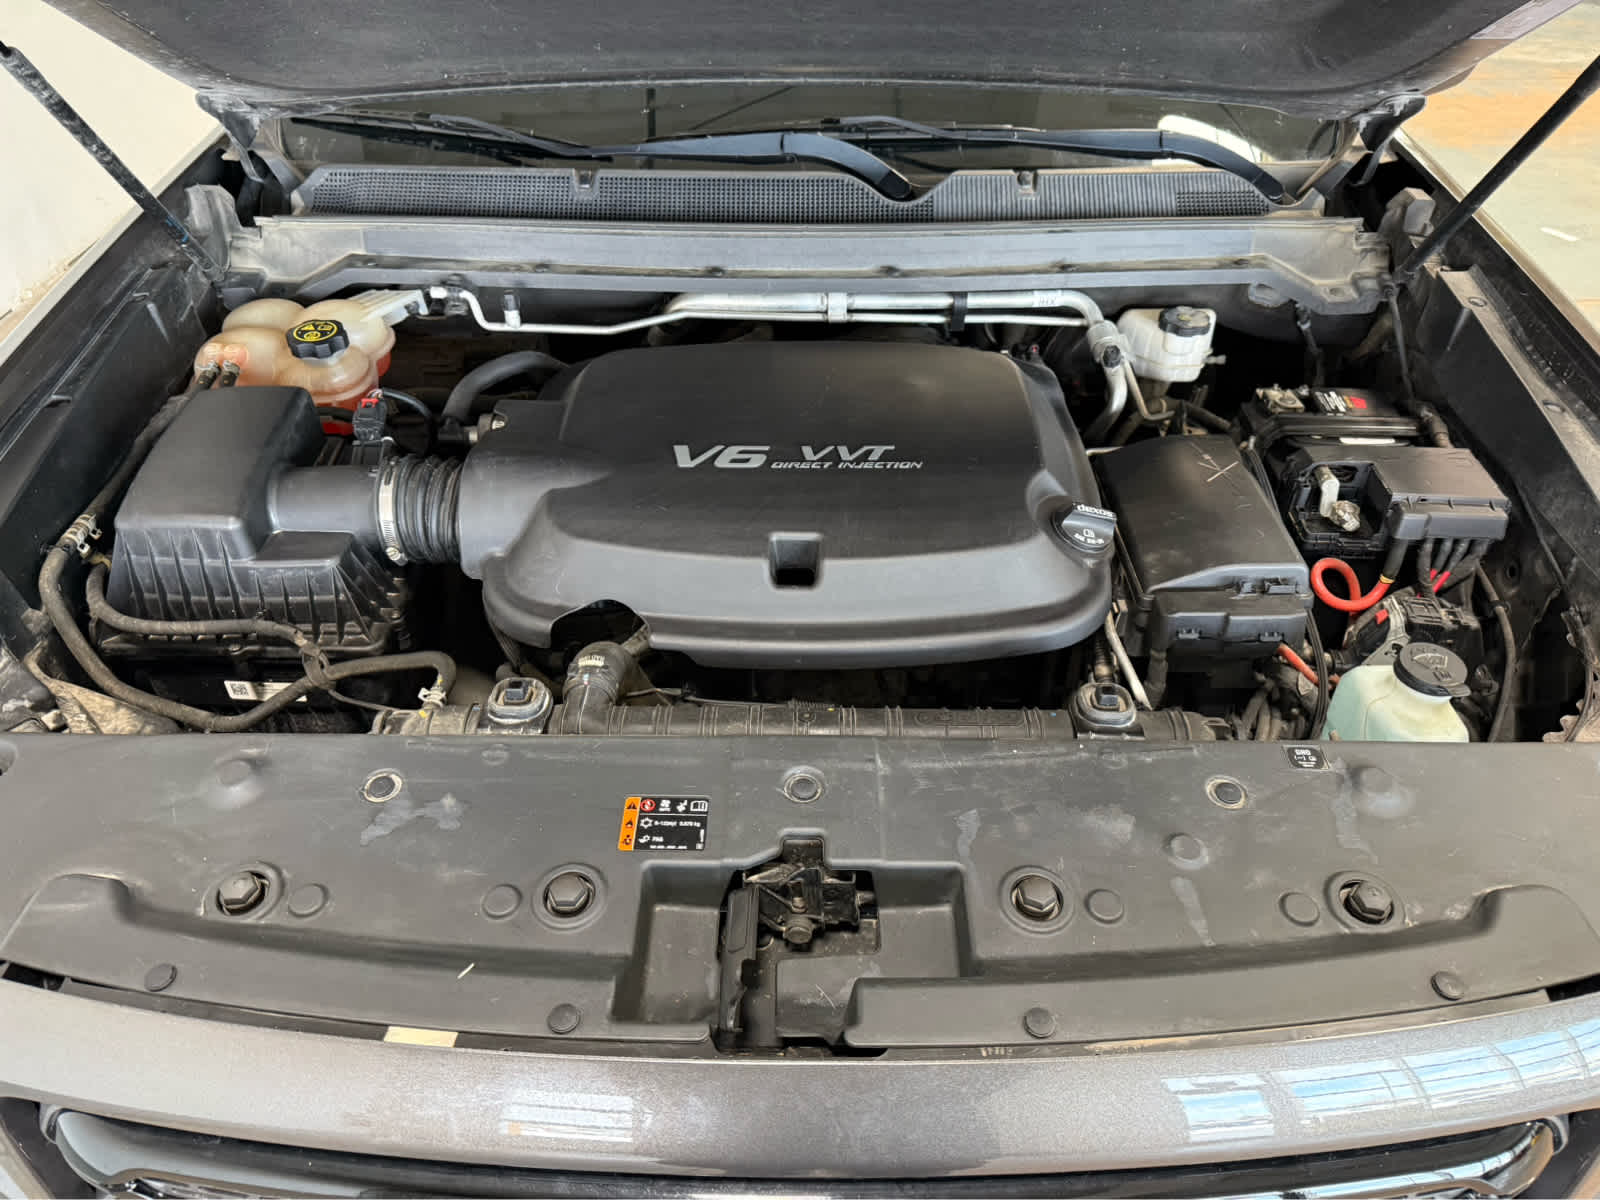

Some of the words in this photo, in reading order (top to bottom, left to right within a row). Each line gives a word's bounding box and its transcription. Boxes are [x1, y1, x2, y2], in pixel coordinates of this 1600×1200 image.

[673, 444, 771, 469] V6
[801, 445, 896, 461] VVT
[770, 461, 833, 469] DIRECT
[837, 461, 924, 469] INJECTION
